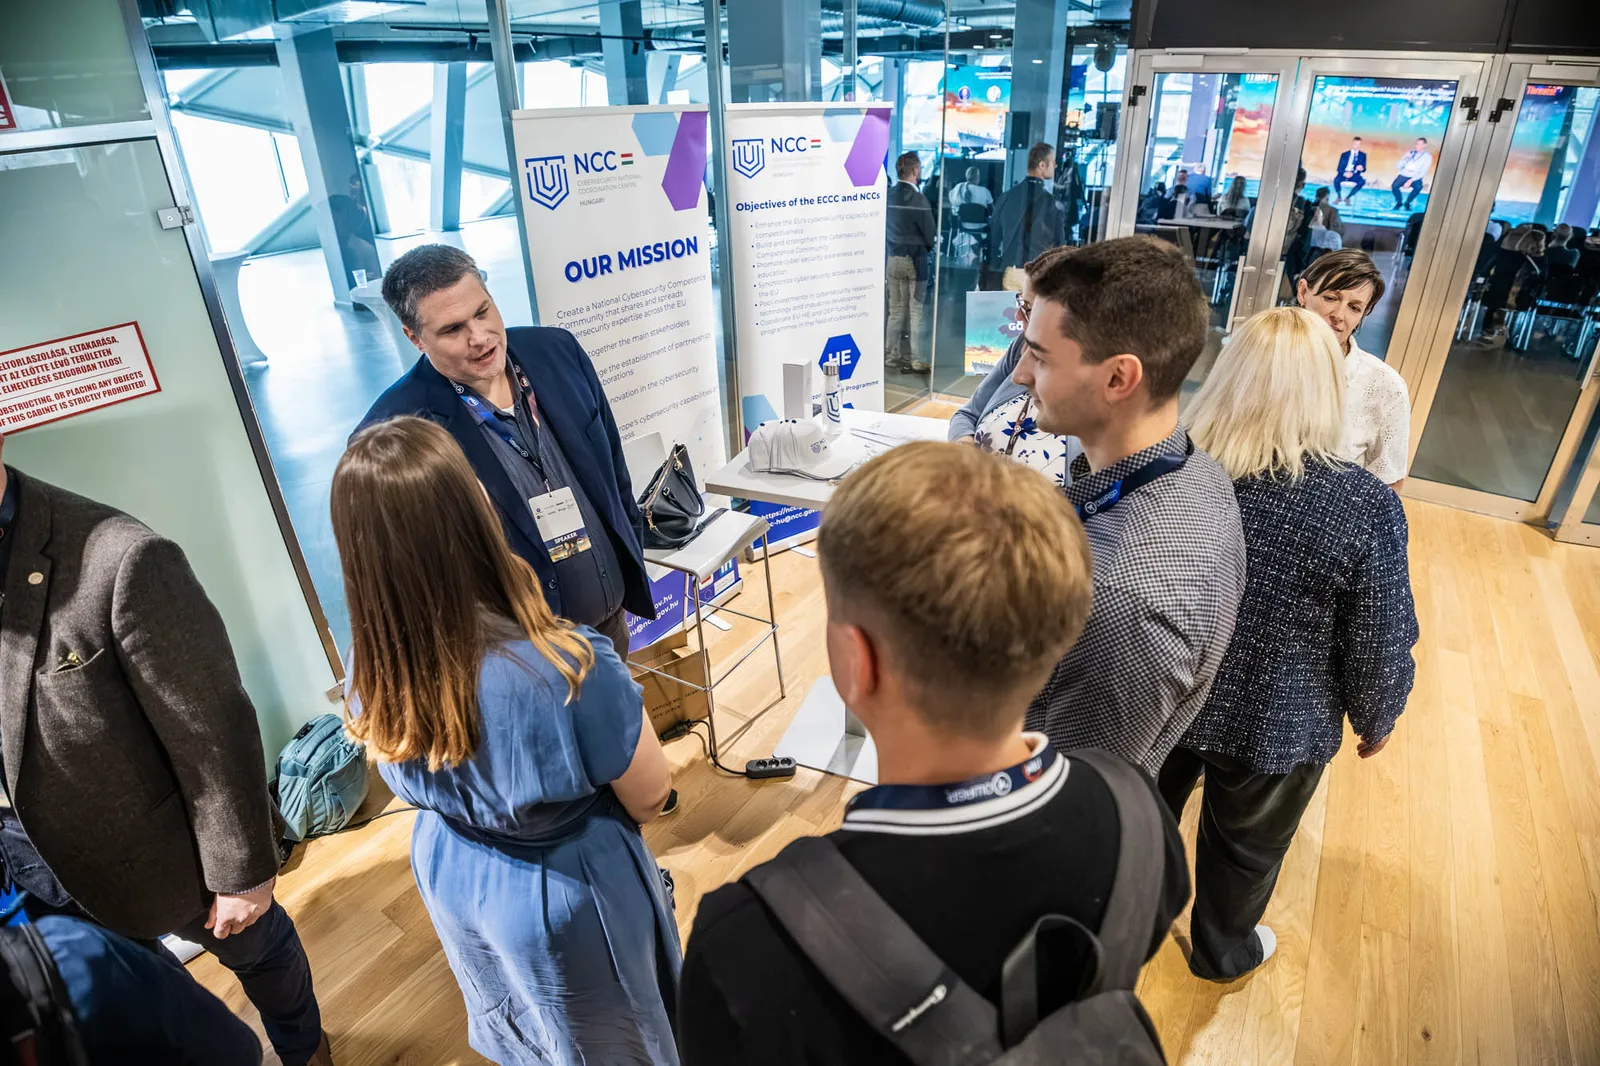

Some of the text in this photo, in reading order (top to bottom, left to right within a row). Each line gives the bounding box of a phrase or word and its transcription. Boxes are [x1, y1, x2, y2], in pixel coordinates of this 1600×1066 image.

[771, 137, 807, 153] NCC
[573, 150, 617, 174] NCC
[580, 197, 605, 206] HUNGARY
[736, 191, 880, 212] Objectives of the ECCC and NCCs
[564, 236, 699, 283] OUR MISSION
[556, 274, 707, 319] Create a National Cybersecurity Competence
[559, 290, 684, 330] Community that shares and spreads
[575, 299, 687, 339] ersecurity expertise across the EU
[69, 335, 120, 354] ELTAKARÁSA,
[588, 319, 690, 358] together the main stakeholders
[9, 370, 21, 381] AZ
[70, 348, 113, 365] TERÜLETEN
[608, 362, 620, 372] the
[621, 346, 667, 368] establishment
[667, 342, 674, 352] of
[1, 374, 53, 394] ELHELYEZÉSE
[52, 362, 98, 381] SZIGORÚAN
[97, 356, 123, 370] TILOS!
[54, 390, 66, 400] OR
[66, 382, 98, 398] PLACING
[98, 378, 113, 389] ANY
[113, 371, 144, 385] OBJECTS
[602, 369, 635, 386] borations
[609, 388, 640, 404] novation
[647, 381, 659, 390] the
[659, 365, 700, 386] cybersecurity
[845, 380, 879, 391] Programme
[6, 413, 26, 425] THIS
[26, 404, 59, 420] CABINET
[59, 401, 68, 410] IS
[68, 392, 101, 408] STRICTLY
[102, 379, 147, 398] PROHIBITED!
[619, 390, 712, 432] rope's cybersecurity capabilities
[621, 431, 636, 442] ness
[554, 531, 578, 544] SPEAKER
